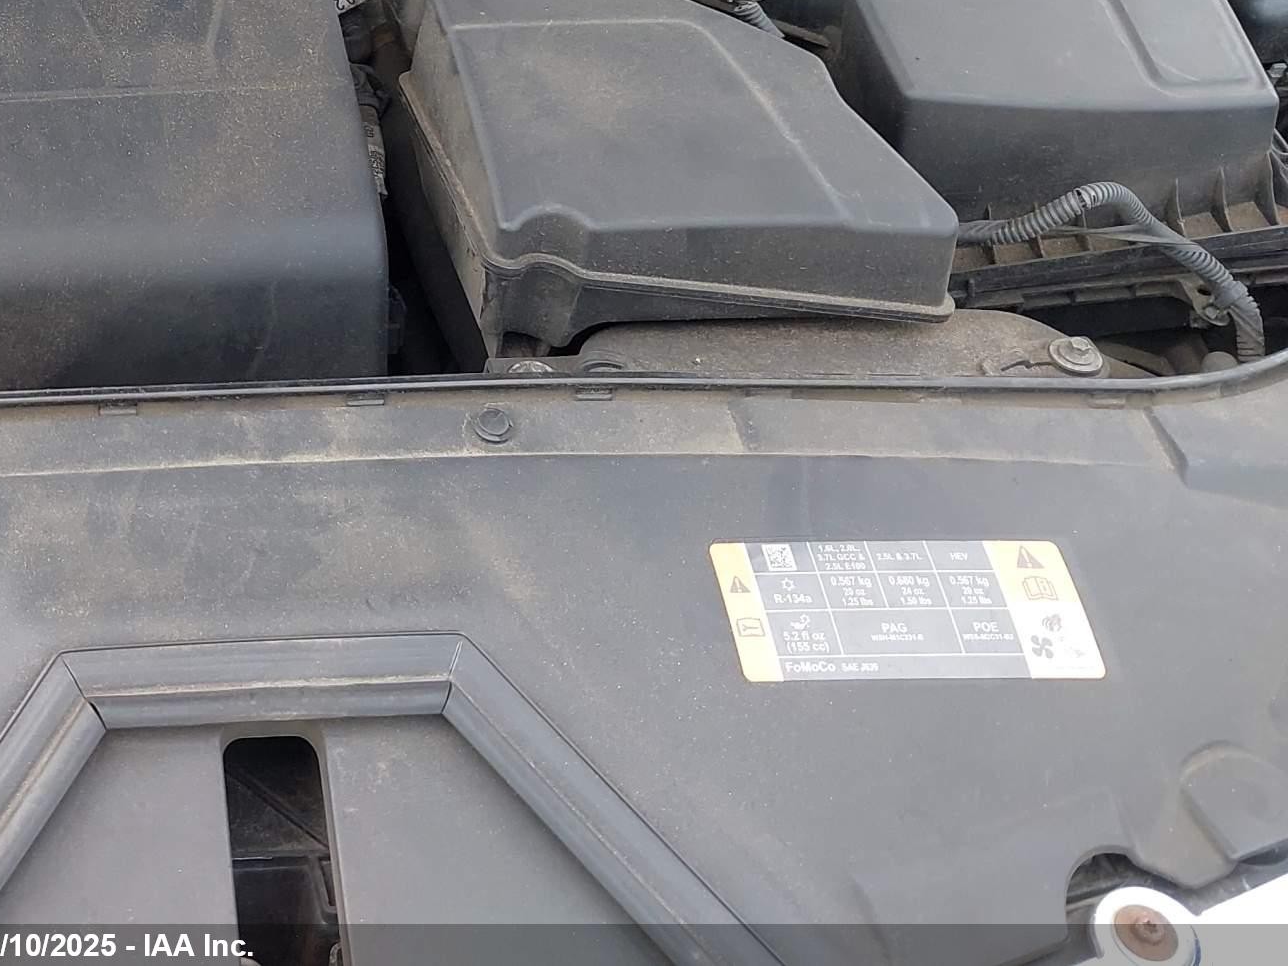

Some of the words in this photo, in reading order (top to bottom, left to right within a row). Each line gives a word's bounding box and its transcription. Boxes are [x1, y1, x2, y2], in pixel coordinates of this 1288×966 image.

[950, 552, 968, 560] HEV
[857, 575, 872, 587] kg
[916, 575, 930, 587] kg
[975, 575, 990, 587] kg
[773, 593, 812, 604] R-134a
[881, 622, 908, 633] PAG
[972, 622, 1000, 633] POE
[783, 631, 800, 641] 5.2
[812, 632, 826, 641] oz
[786, 641, 810, 654] (155
[812, 641, 830, 653] cc)
[785, 661, 836, 673] FoMoCo
